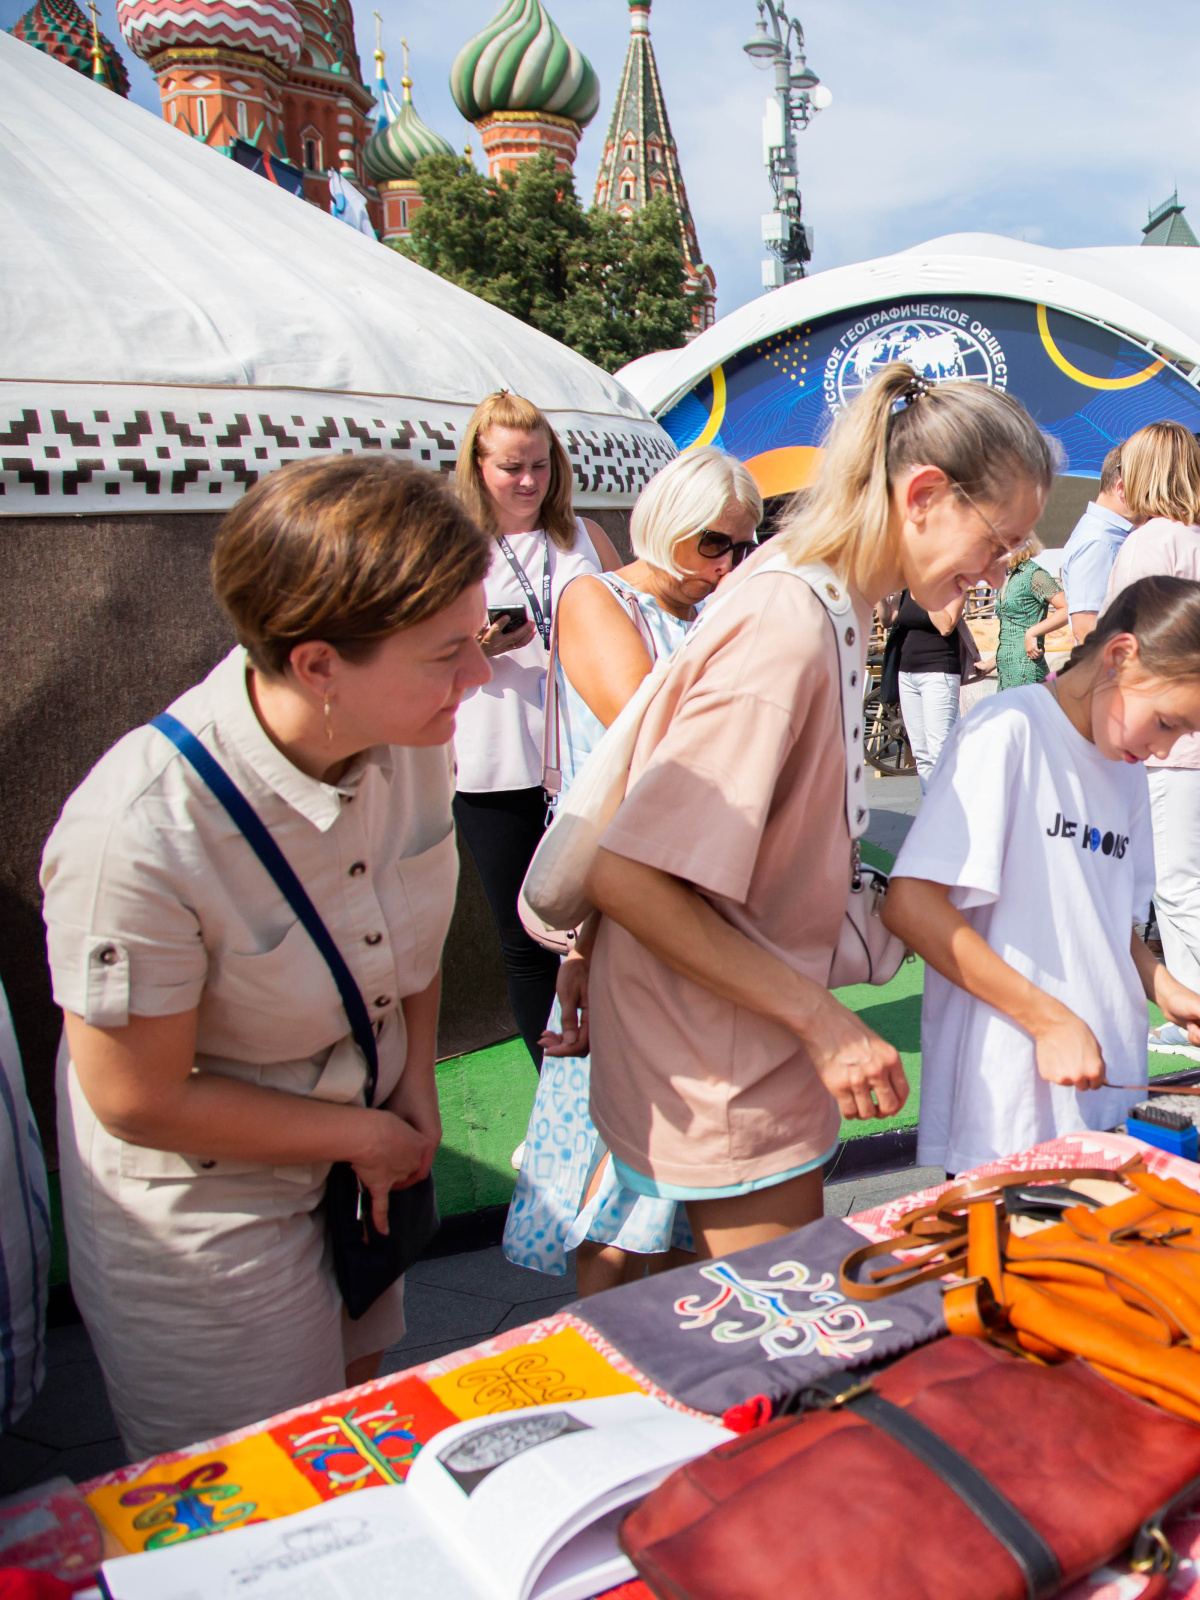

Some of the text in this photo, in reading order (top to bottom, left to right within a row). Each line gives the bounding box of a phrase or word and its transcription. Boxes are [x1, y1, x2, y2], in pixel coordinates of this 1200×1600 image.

[823, 304, 1008, 418] УССКОЕ ГЕОГРАФИЧЕСКОЕ ОБЩЕСТ
